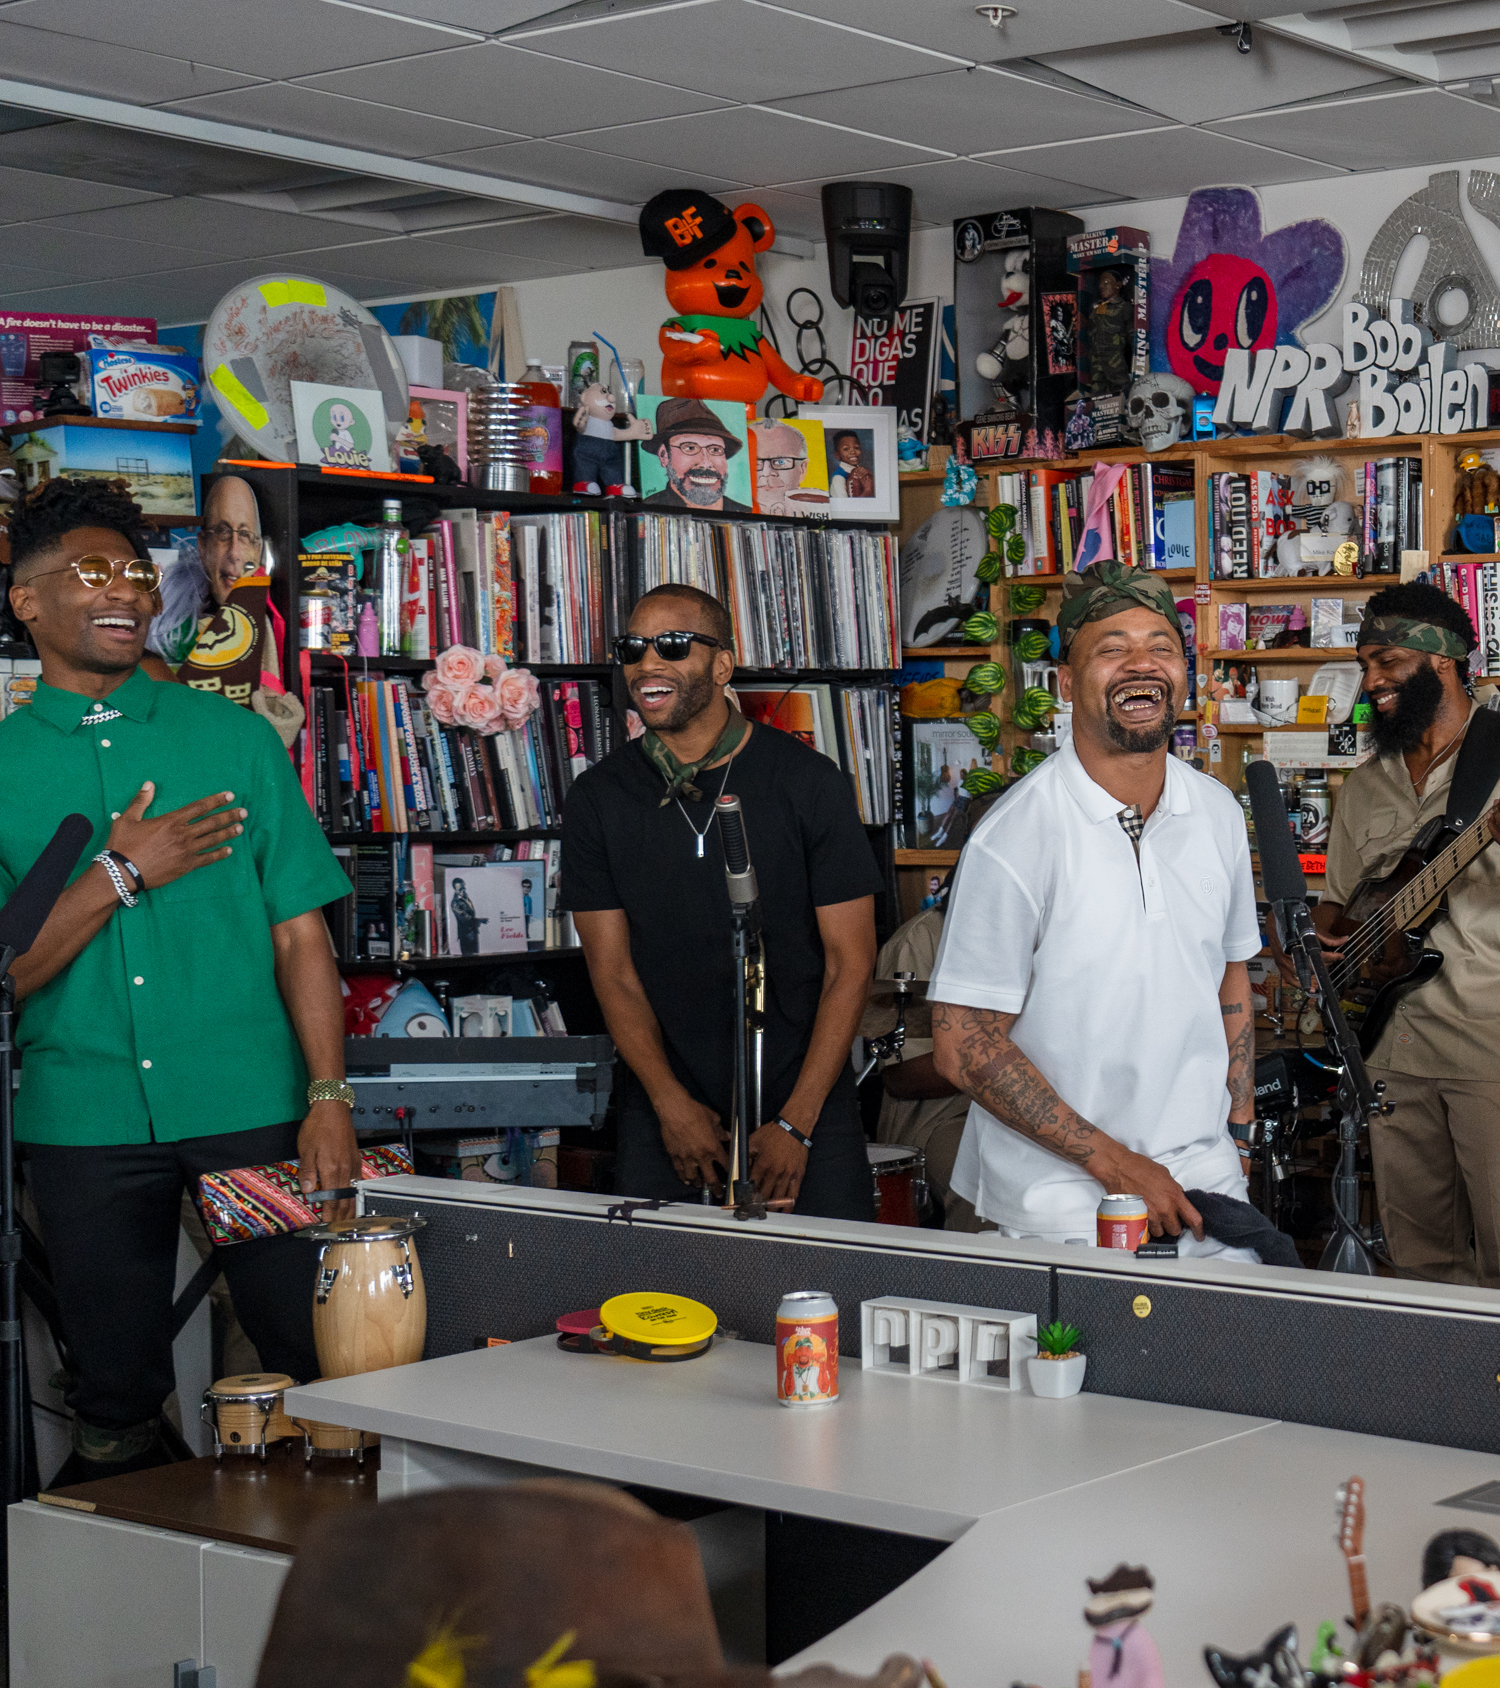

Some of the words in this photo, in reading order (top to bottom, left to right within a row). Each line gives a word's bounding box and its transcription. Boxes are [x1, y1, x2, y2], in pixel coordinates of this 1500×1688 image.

[1069, 236, 1108, 254] MASTER
[1082, 229, 1107, 240] TALKING
[1137, 255, 1148, 320] MASTER
[6, 318, 21, 328] fire
[23, 319, 57, 329] doesn't
[57, 321, 80, 330] have
[81, 322, 91, 331] to
[92, 322, 104, 331] be
[112, 323, 152, 333] disaster...
[893, 308, 926, 333] ME
[854, 334, 917, 364] DIGAS
[1343, 299, 1430, 374] Bob
[102, 356, 133, 368] Hostess
[853, 362, 897, 387] QUE
[100, 367, 170, 399] Twinkies
[1213, 343, 1351, 438] NPR
[1359, 342, 1490, 438] Boilen
[971, 423, 1022, 459] KISS
[324, 447, 370, 466] Louie
[1265, 489, 1296, 507] ASK
[1167, 544, 1191, 558] LOUIE
[1231, 526, 1248, 578] REED
[1484, 563, 1498, 604] THIS
[1249, 614, 1287, 626] NOW
[1486, 638, 1500, 677] CALL
[593, 695, 601, 728] LEONARD
[932, 729, 956, 738] mirror
[1302, 811, 1316, 824] PA
[500, 932, 524, 940] Fields
[874, 1307, 1010, 1369] npr
